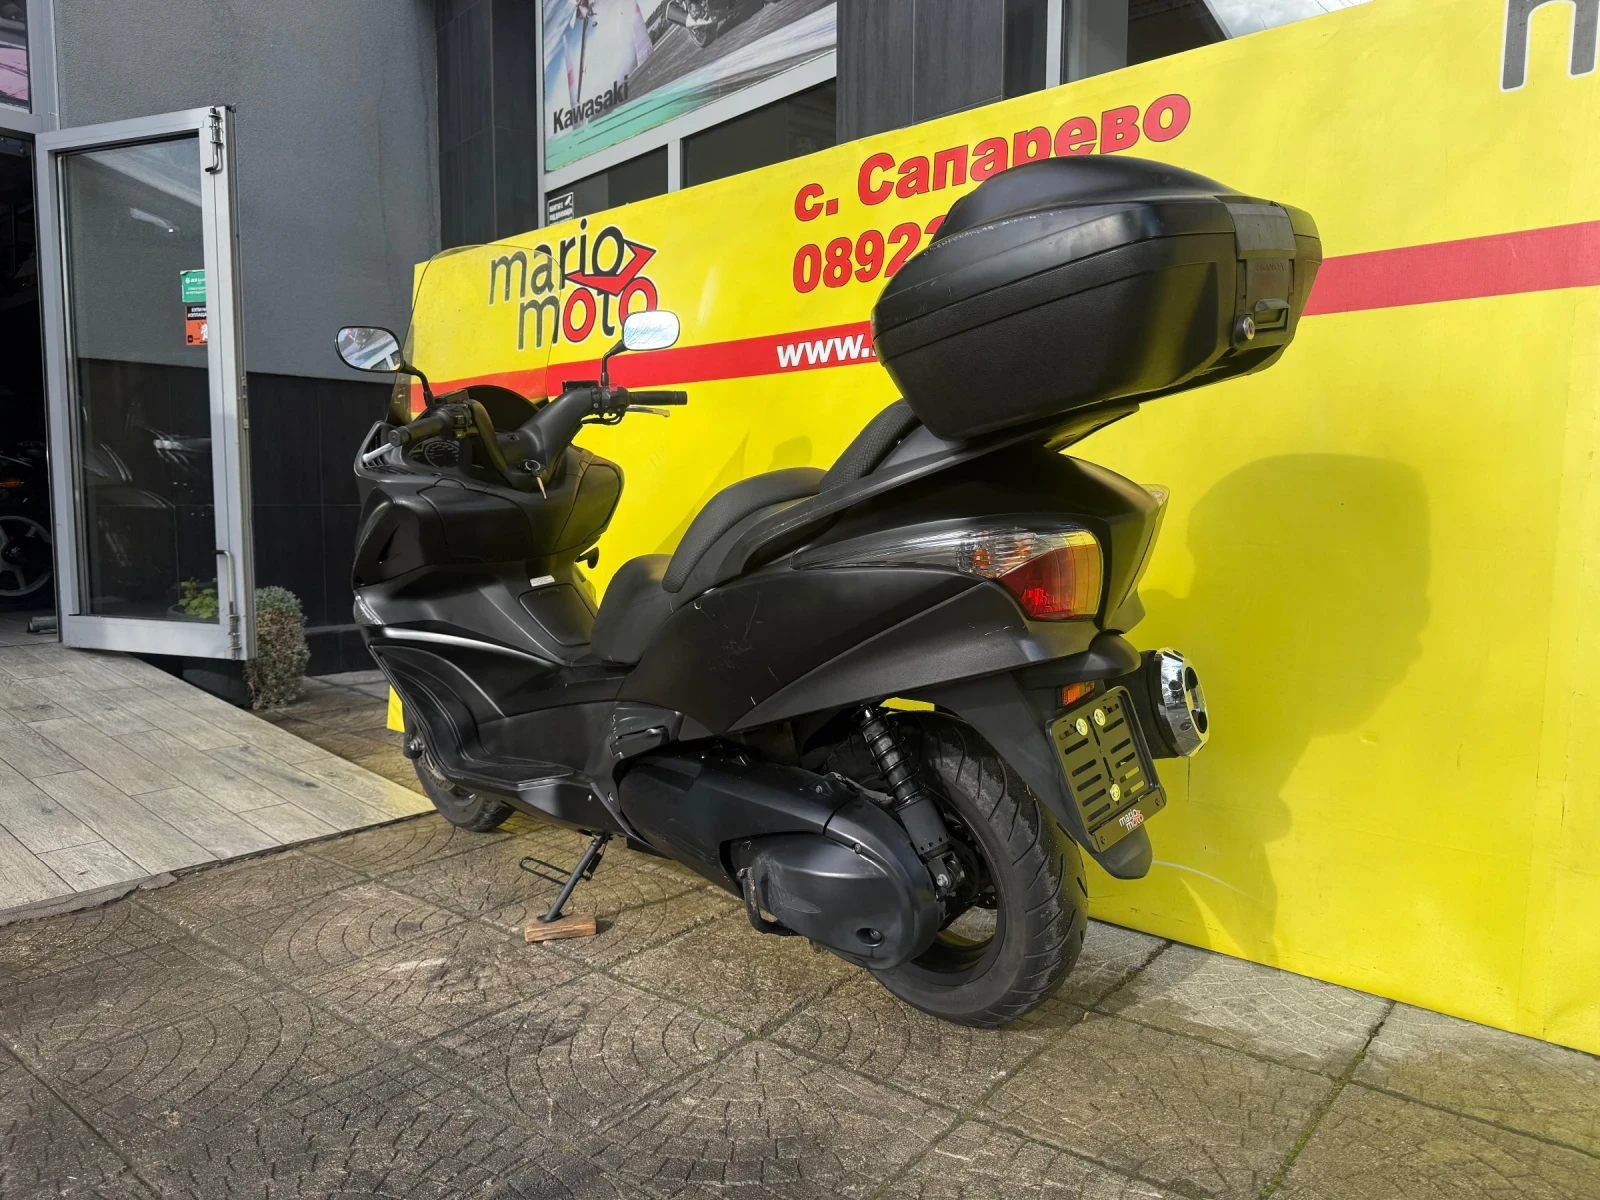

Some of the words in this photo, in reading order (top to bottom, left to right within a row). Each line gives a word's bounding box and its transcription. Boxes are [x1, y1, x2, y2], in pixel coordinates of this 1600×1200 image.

[553, 75, 629, 134] Kawasaki
[794, 183, 839, 221] с.
[857, 93, 1191, 206] Сапарево
[489, 218, 626, 305] mario
[776, 334, 877, 368] www.
[1119, 808, 1137, 827] mario
[1125, 815, 1144, 831] moto
